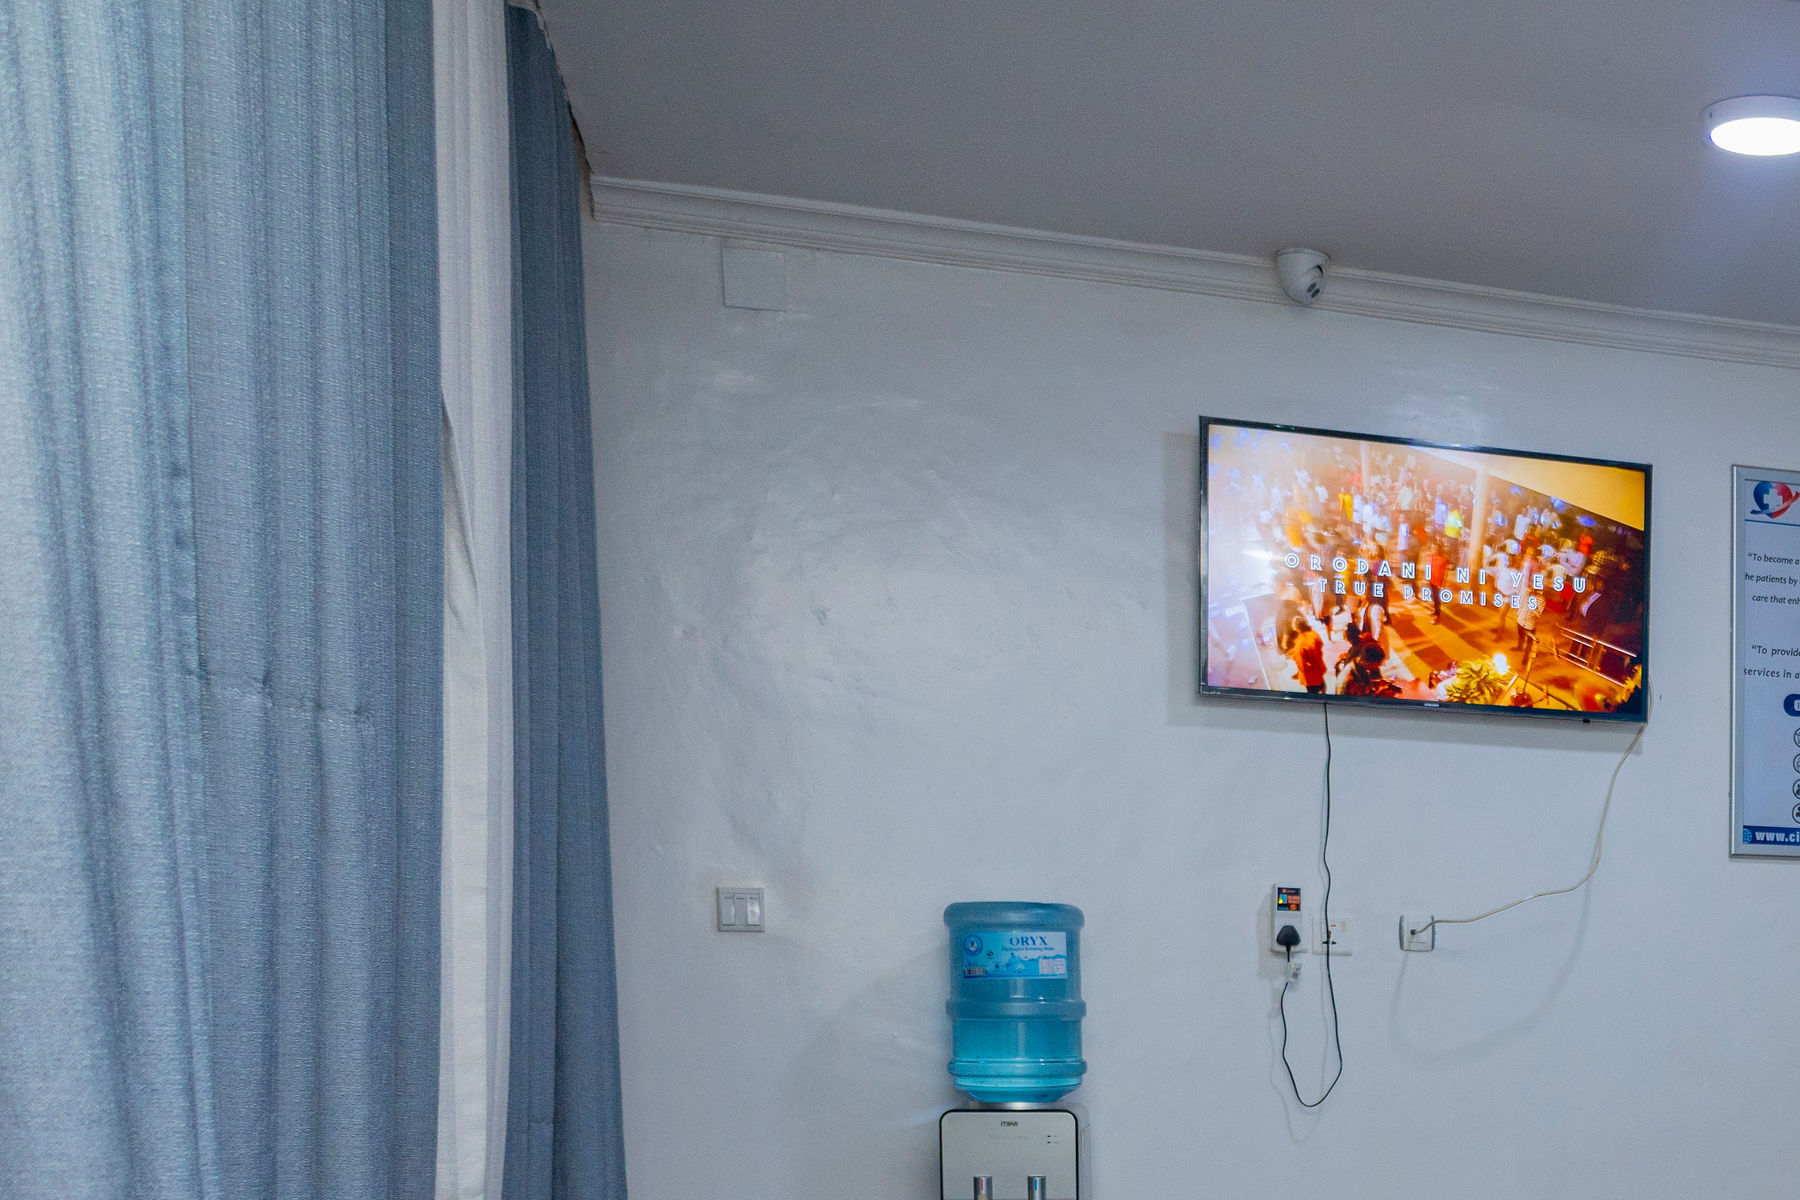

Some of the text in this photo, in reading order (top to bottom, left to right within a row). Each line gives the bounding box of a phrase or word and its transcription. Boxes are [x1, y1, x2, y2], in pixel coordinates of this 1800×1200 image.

[1763, 554, 1793, 565] become
[1456, 567, 1486, 584] NI
[1511, 572, 1587, 593] YESU
[1756, 574, 1787, 584] patients
[1788, 577, 1798, 587] by
[1319, 578, 1538, 610] TRUE PROMISES
[1752, 595, 1769, 603] care
[1770, 595, 1786, 604] that
[1744, 668, 1780, 678] services
[1783, 669, 1792, 678] in
[1010, 936, 1048, 946] ORYX
